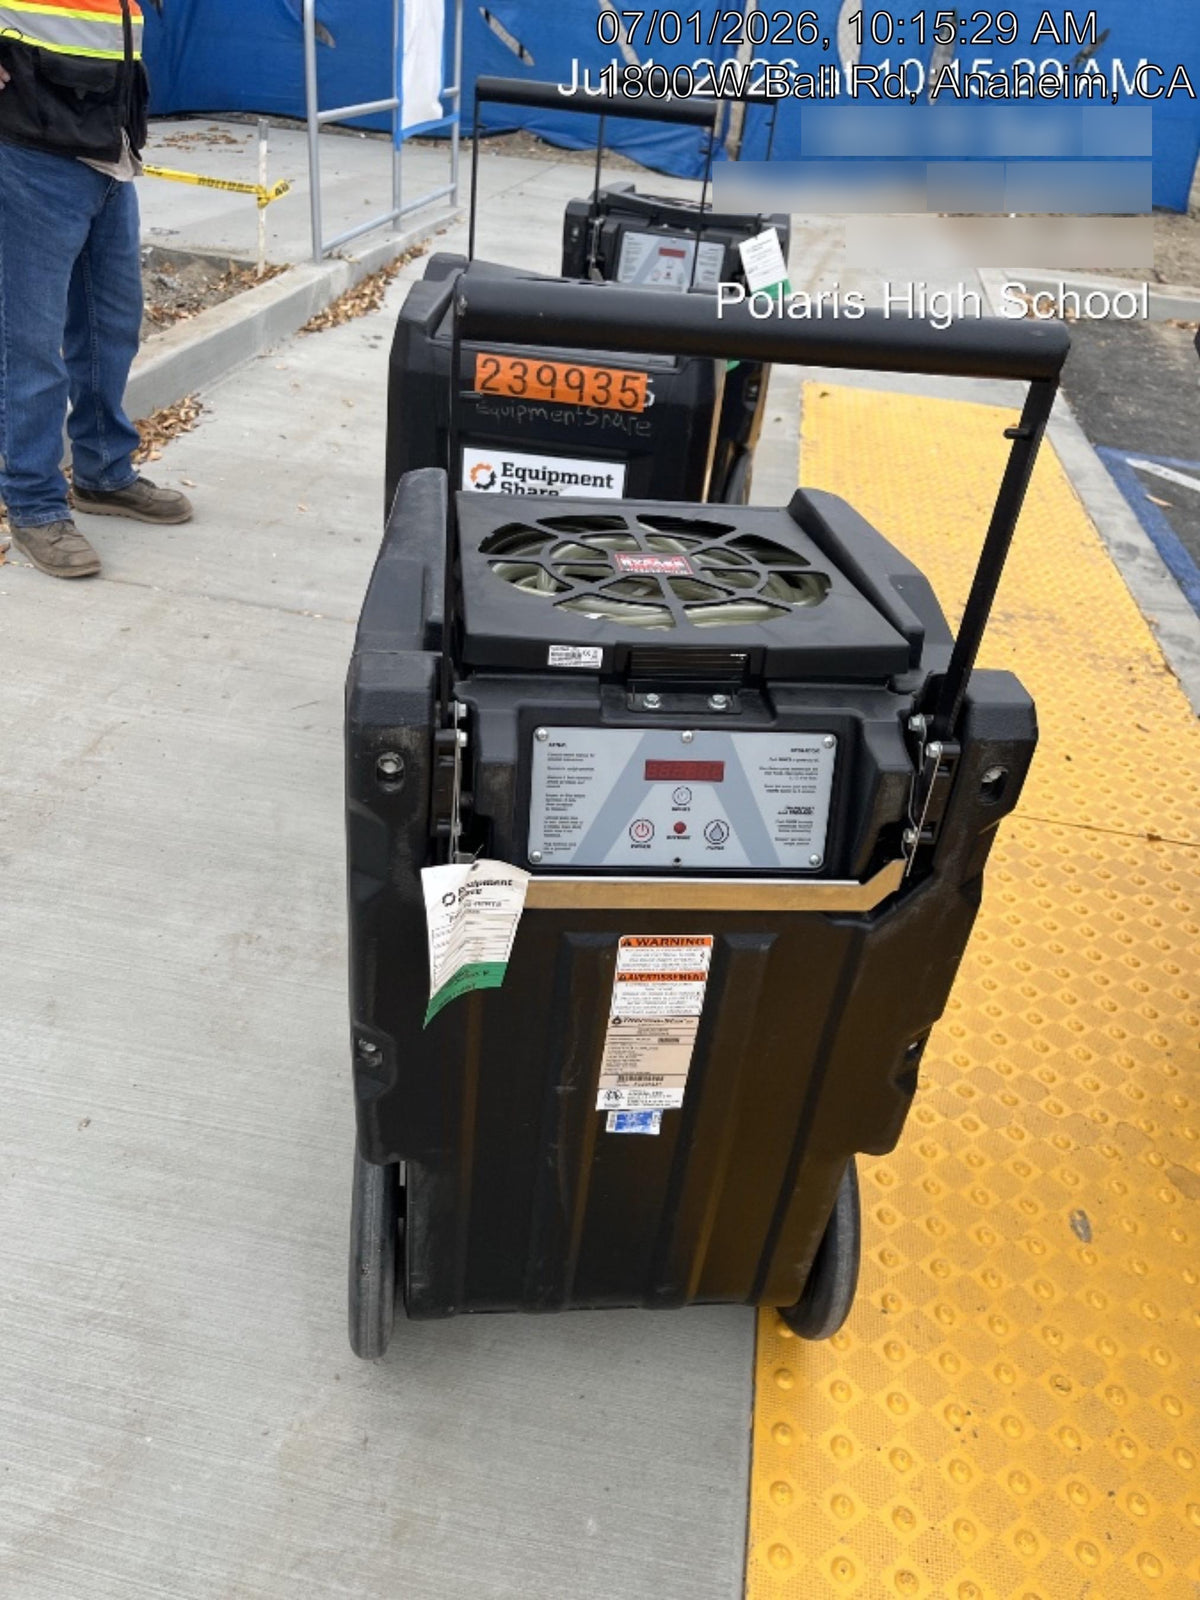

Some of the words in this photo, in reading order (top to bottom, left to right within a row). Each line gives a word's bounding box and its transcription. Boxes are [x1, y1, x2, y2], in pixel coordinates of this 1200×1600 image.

[479, 358, 640, 409] 239935
[501, 462, 614, 489] Equipment
[636, 937, 705, 947] WARNING
